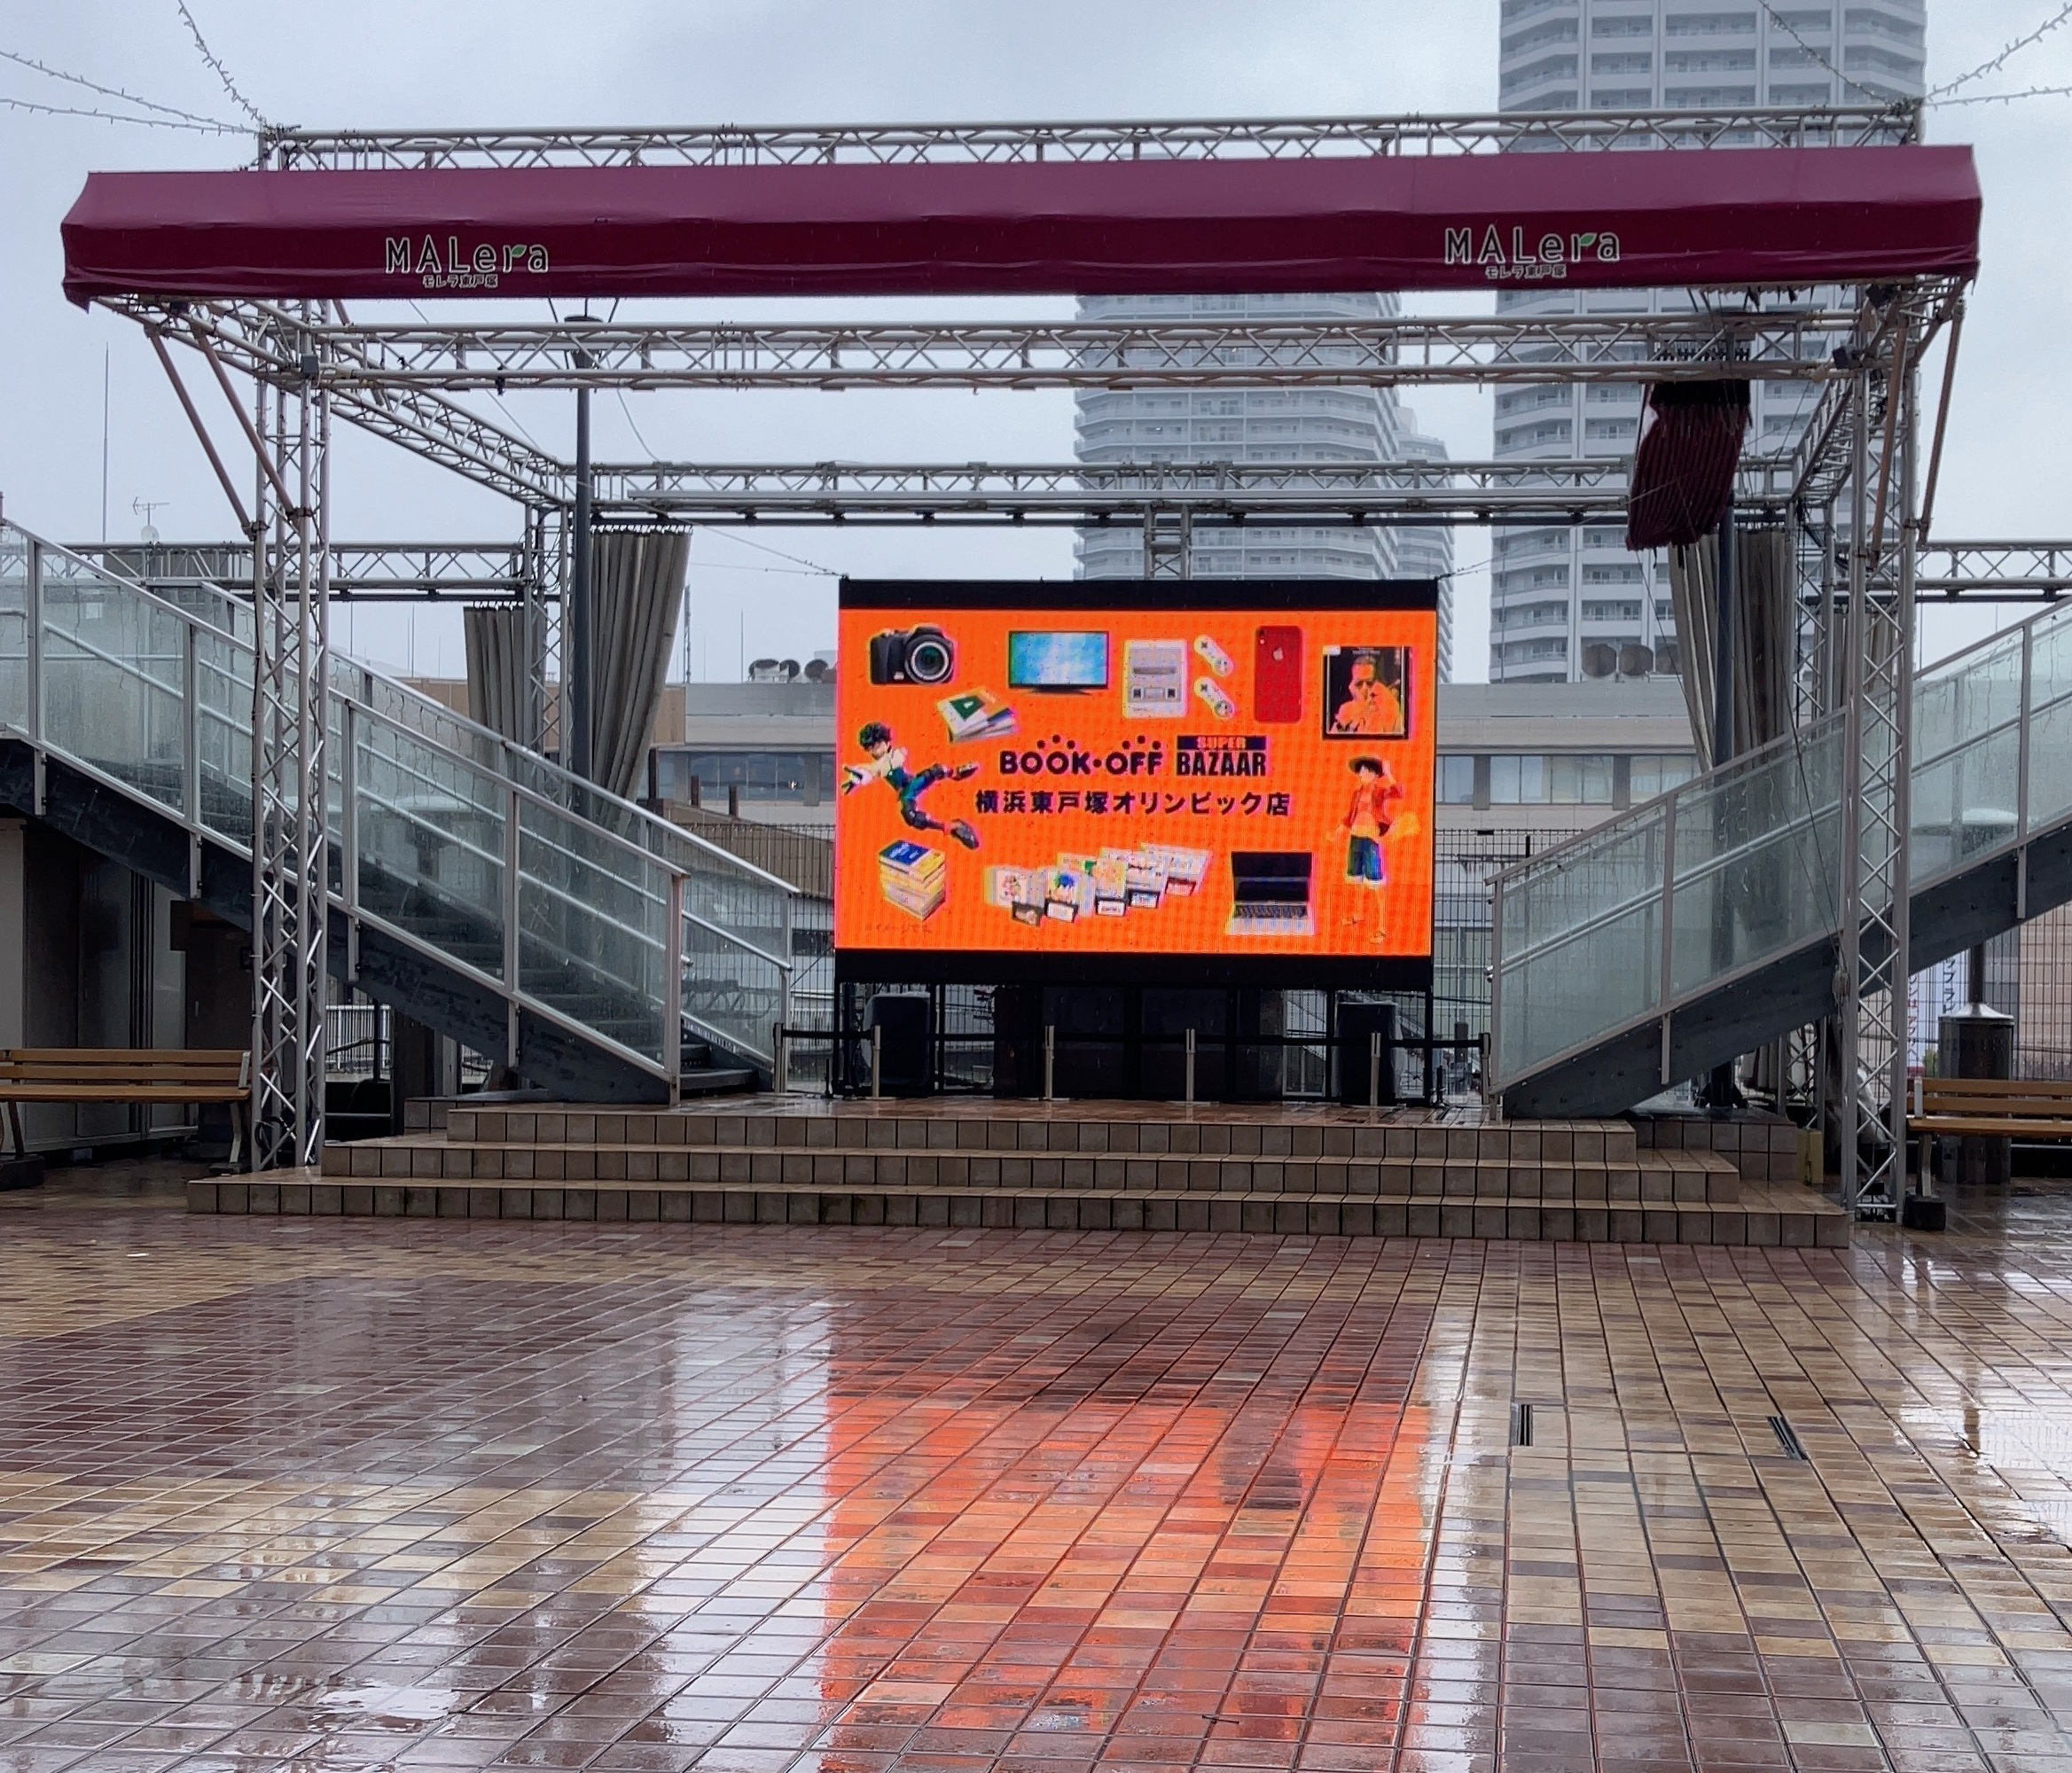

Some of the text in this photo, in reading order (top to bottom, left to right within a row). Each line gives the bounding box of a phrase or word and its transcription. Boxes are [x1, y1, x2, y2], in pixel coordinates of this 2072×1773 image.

[386, 234, 549, 274] MALera
[1444, 223, 1621, 264] MALera
[1177, 752, 1267, 777] BAZAAR
